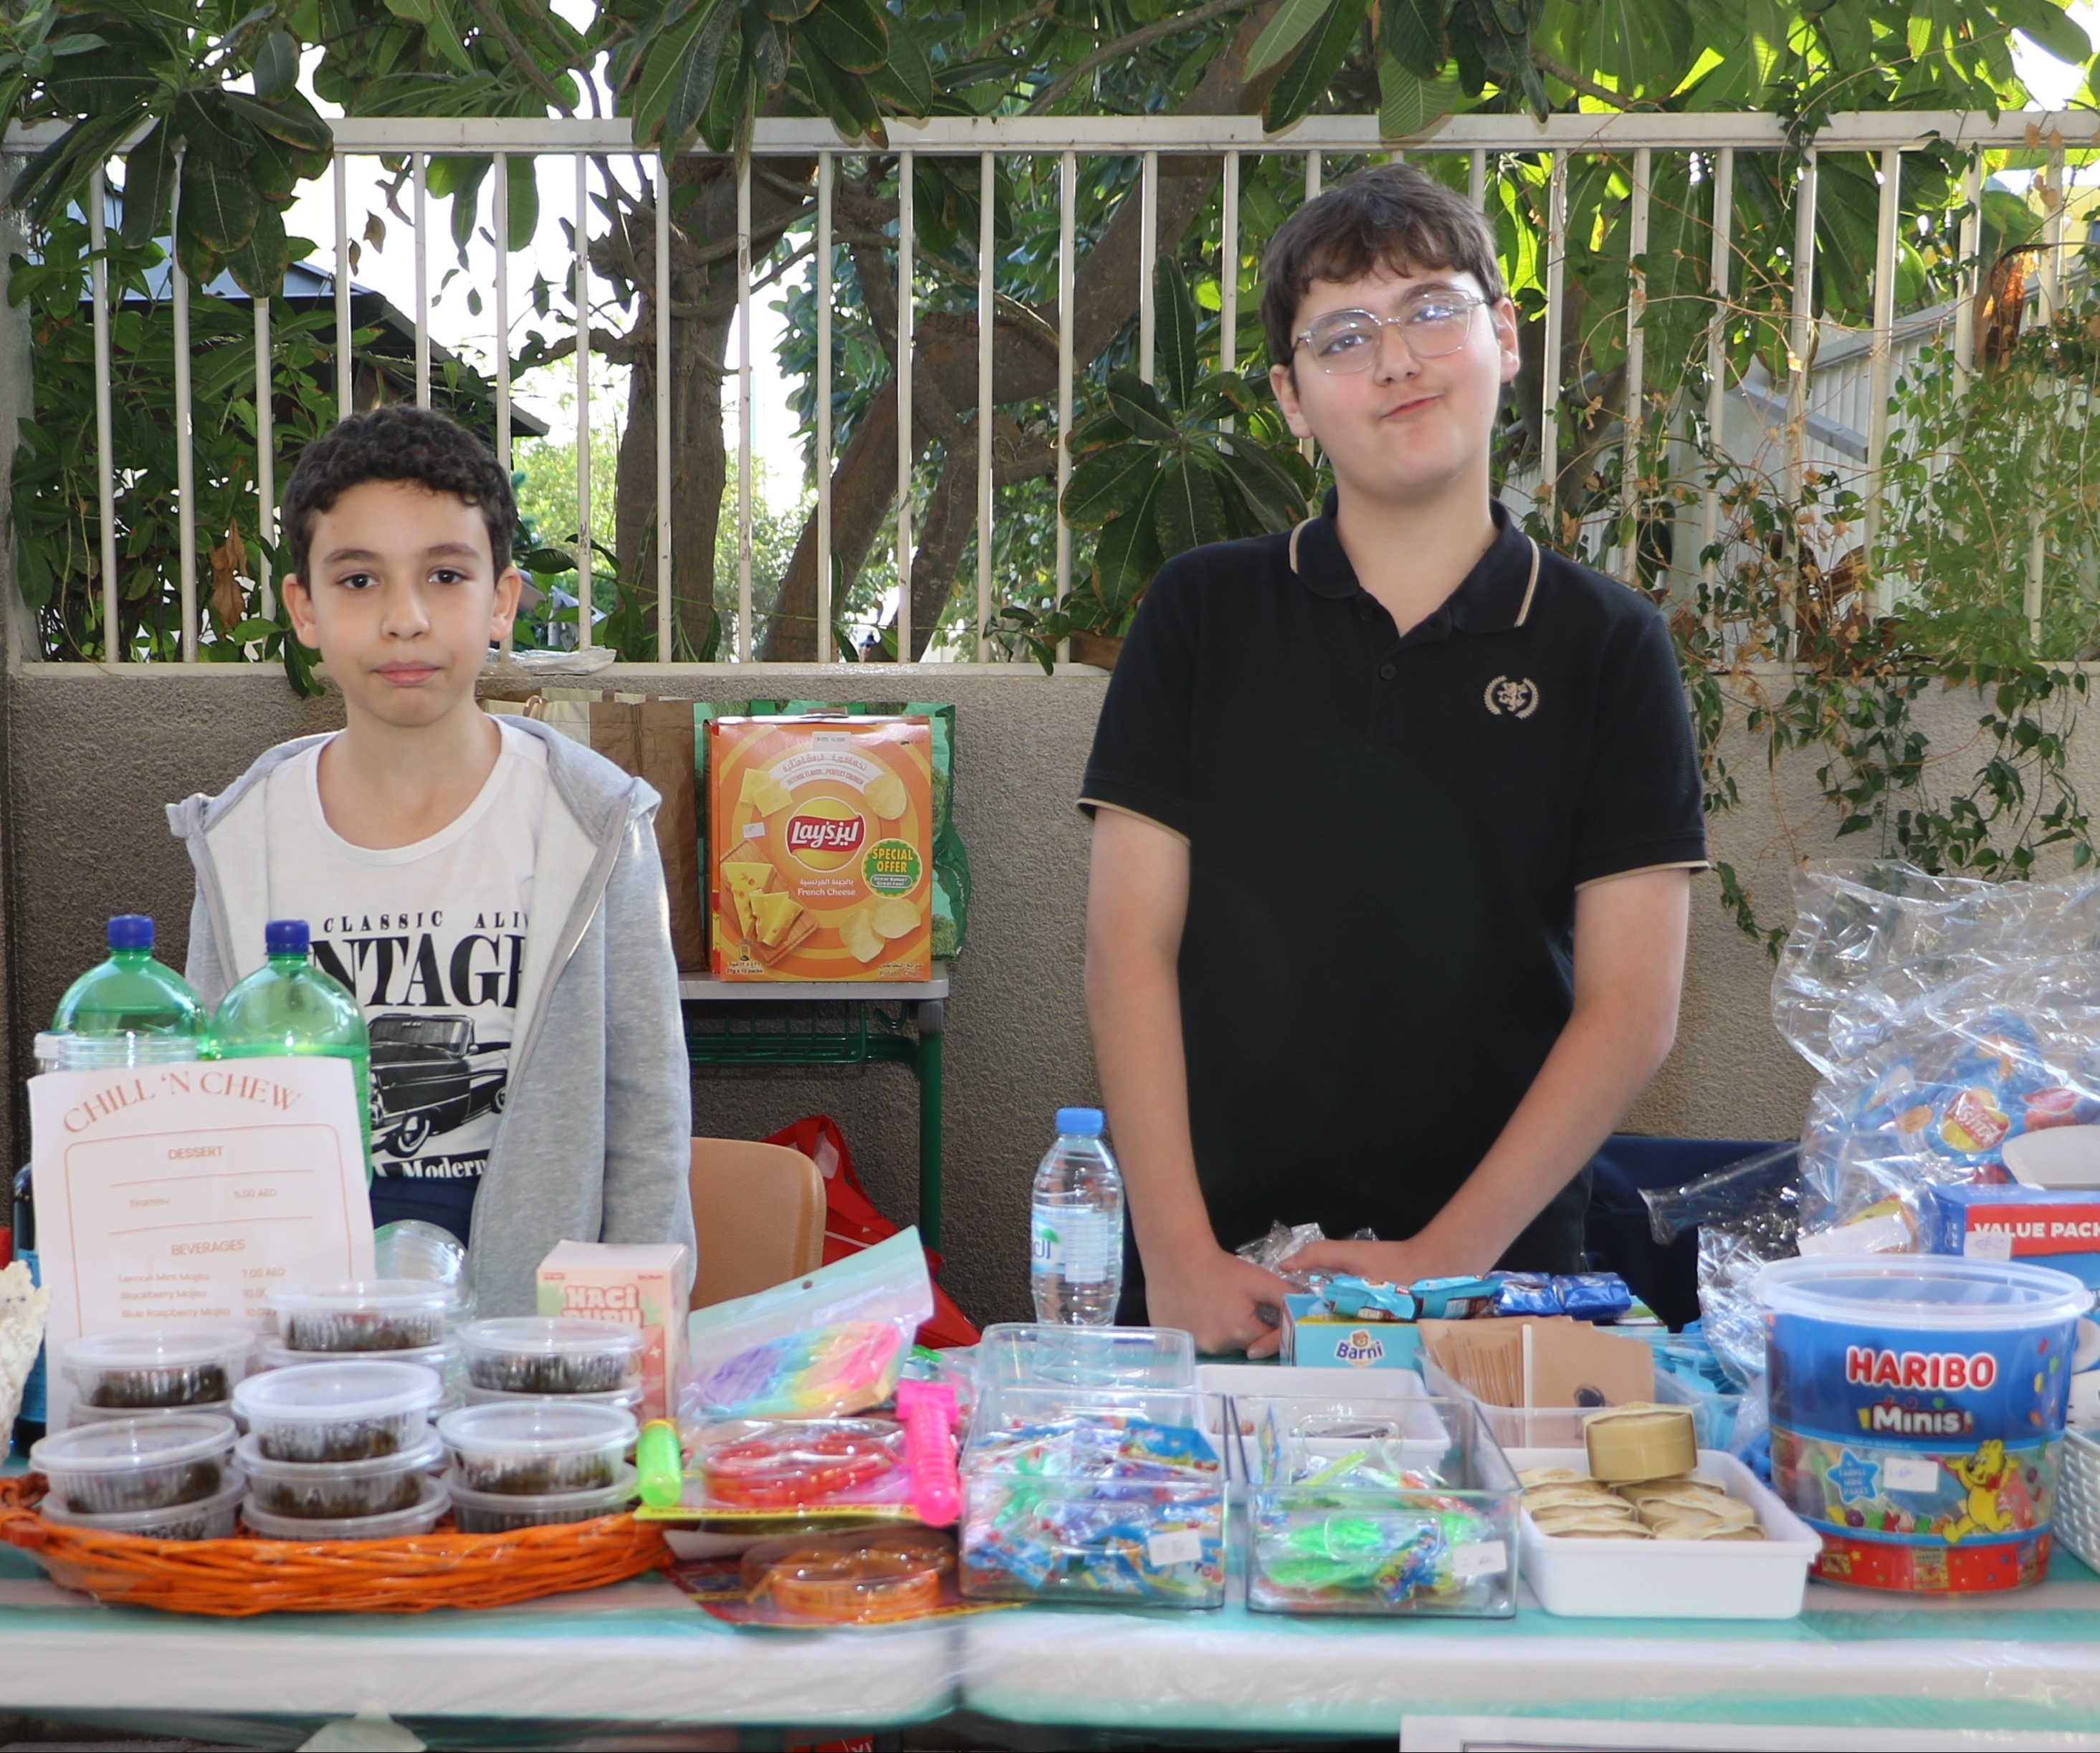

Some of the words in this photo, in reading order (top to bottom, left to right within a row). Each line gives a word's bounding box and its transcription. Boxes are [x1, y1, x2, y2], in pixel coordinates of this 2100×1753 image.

[791, 821, 836, 849] Lay's
[828, 821, 859, 846] ليز
[872, 848, 913, 860] SPECIAL
[876, 861, 907, 873] OFFER
[797, 888, 826, 897] French
[826, 888, 856, 897] Cheese
[323, 910, 444, 933] CLASSIC
[63, 1078, 156, 1133] CHILL
[199, 1070, 302, 1111] CHEW
[168, 1145, 224, 1160] DESSERT
[130, 1197, 171, 1208] Tiramisu
[257, 1188, 277, 1198] AED
[1973, 1222, 2046, 1238] VALUE
[171, 1238, 246, 1256] BEVERAGES
[119, 1274, 154, 1284] Lemon
[156, 1273, 178, 1281] Mint
[179, 1271, 211, 1281] Mojito
[241, 1268, 263, 1279] 7.00
[265, 1267, 286, 1277] AED
[120, 1290, 174, 1301] Blackberry
[176, 1289, 208, 1299] Mojito
[122, 1308, 144, 1318] Blue
[145, 1307, 199, 1319] Raspberry
[199, 1307, 231, 1317] Mojito
[1336, 1340, 1383, 1360] Barni
[1846, 1345, 1996, 1391] HARIBO
[1872, 1404, 1961, 1434] Minis
